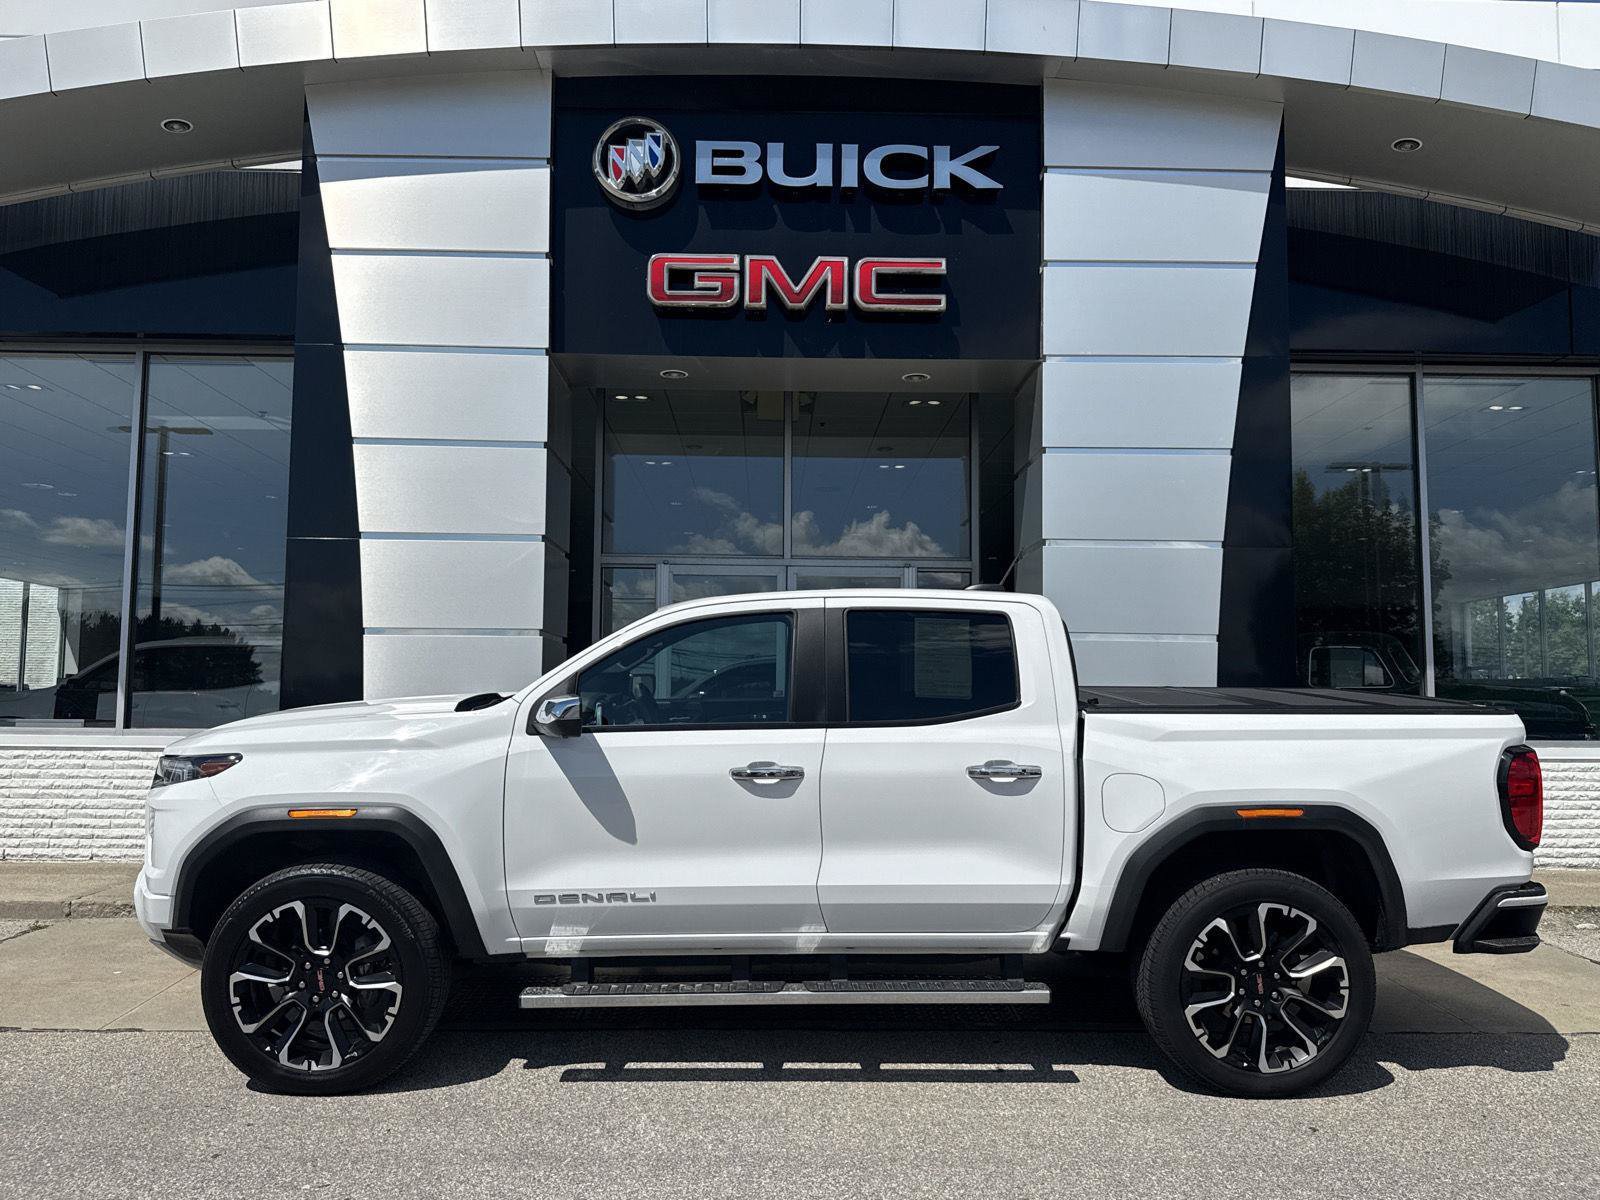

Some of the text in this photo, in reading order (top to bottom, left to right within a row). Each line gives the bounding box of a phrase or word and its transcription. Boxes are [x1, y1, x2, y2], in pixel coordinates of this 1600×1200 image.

[695, 140, 1003, 190] BUICK
[646, 252, 947, 313] GMC
[533, 892, 657, 906] DENALI
